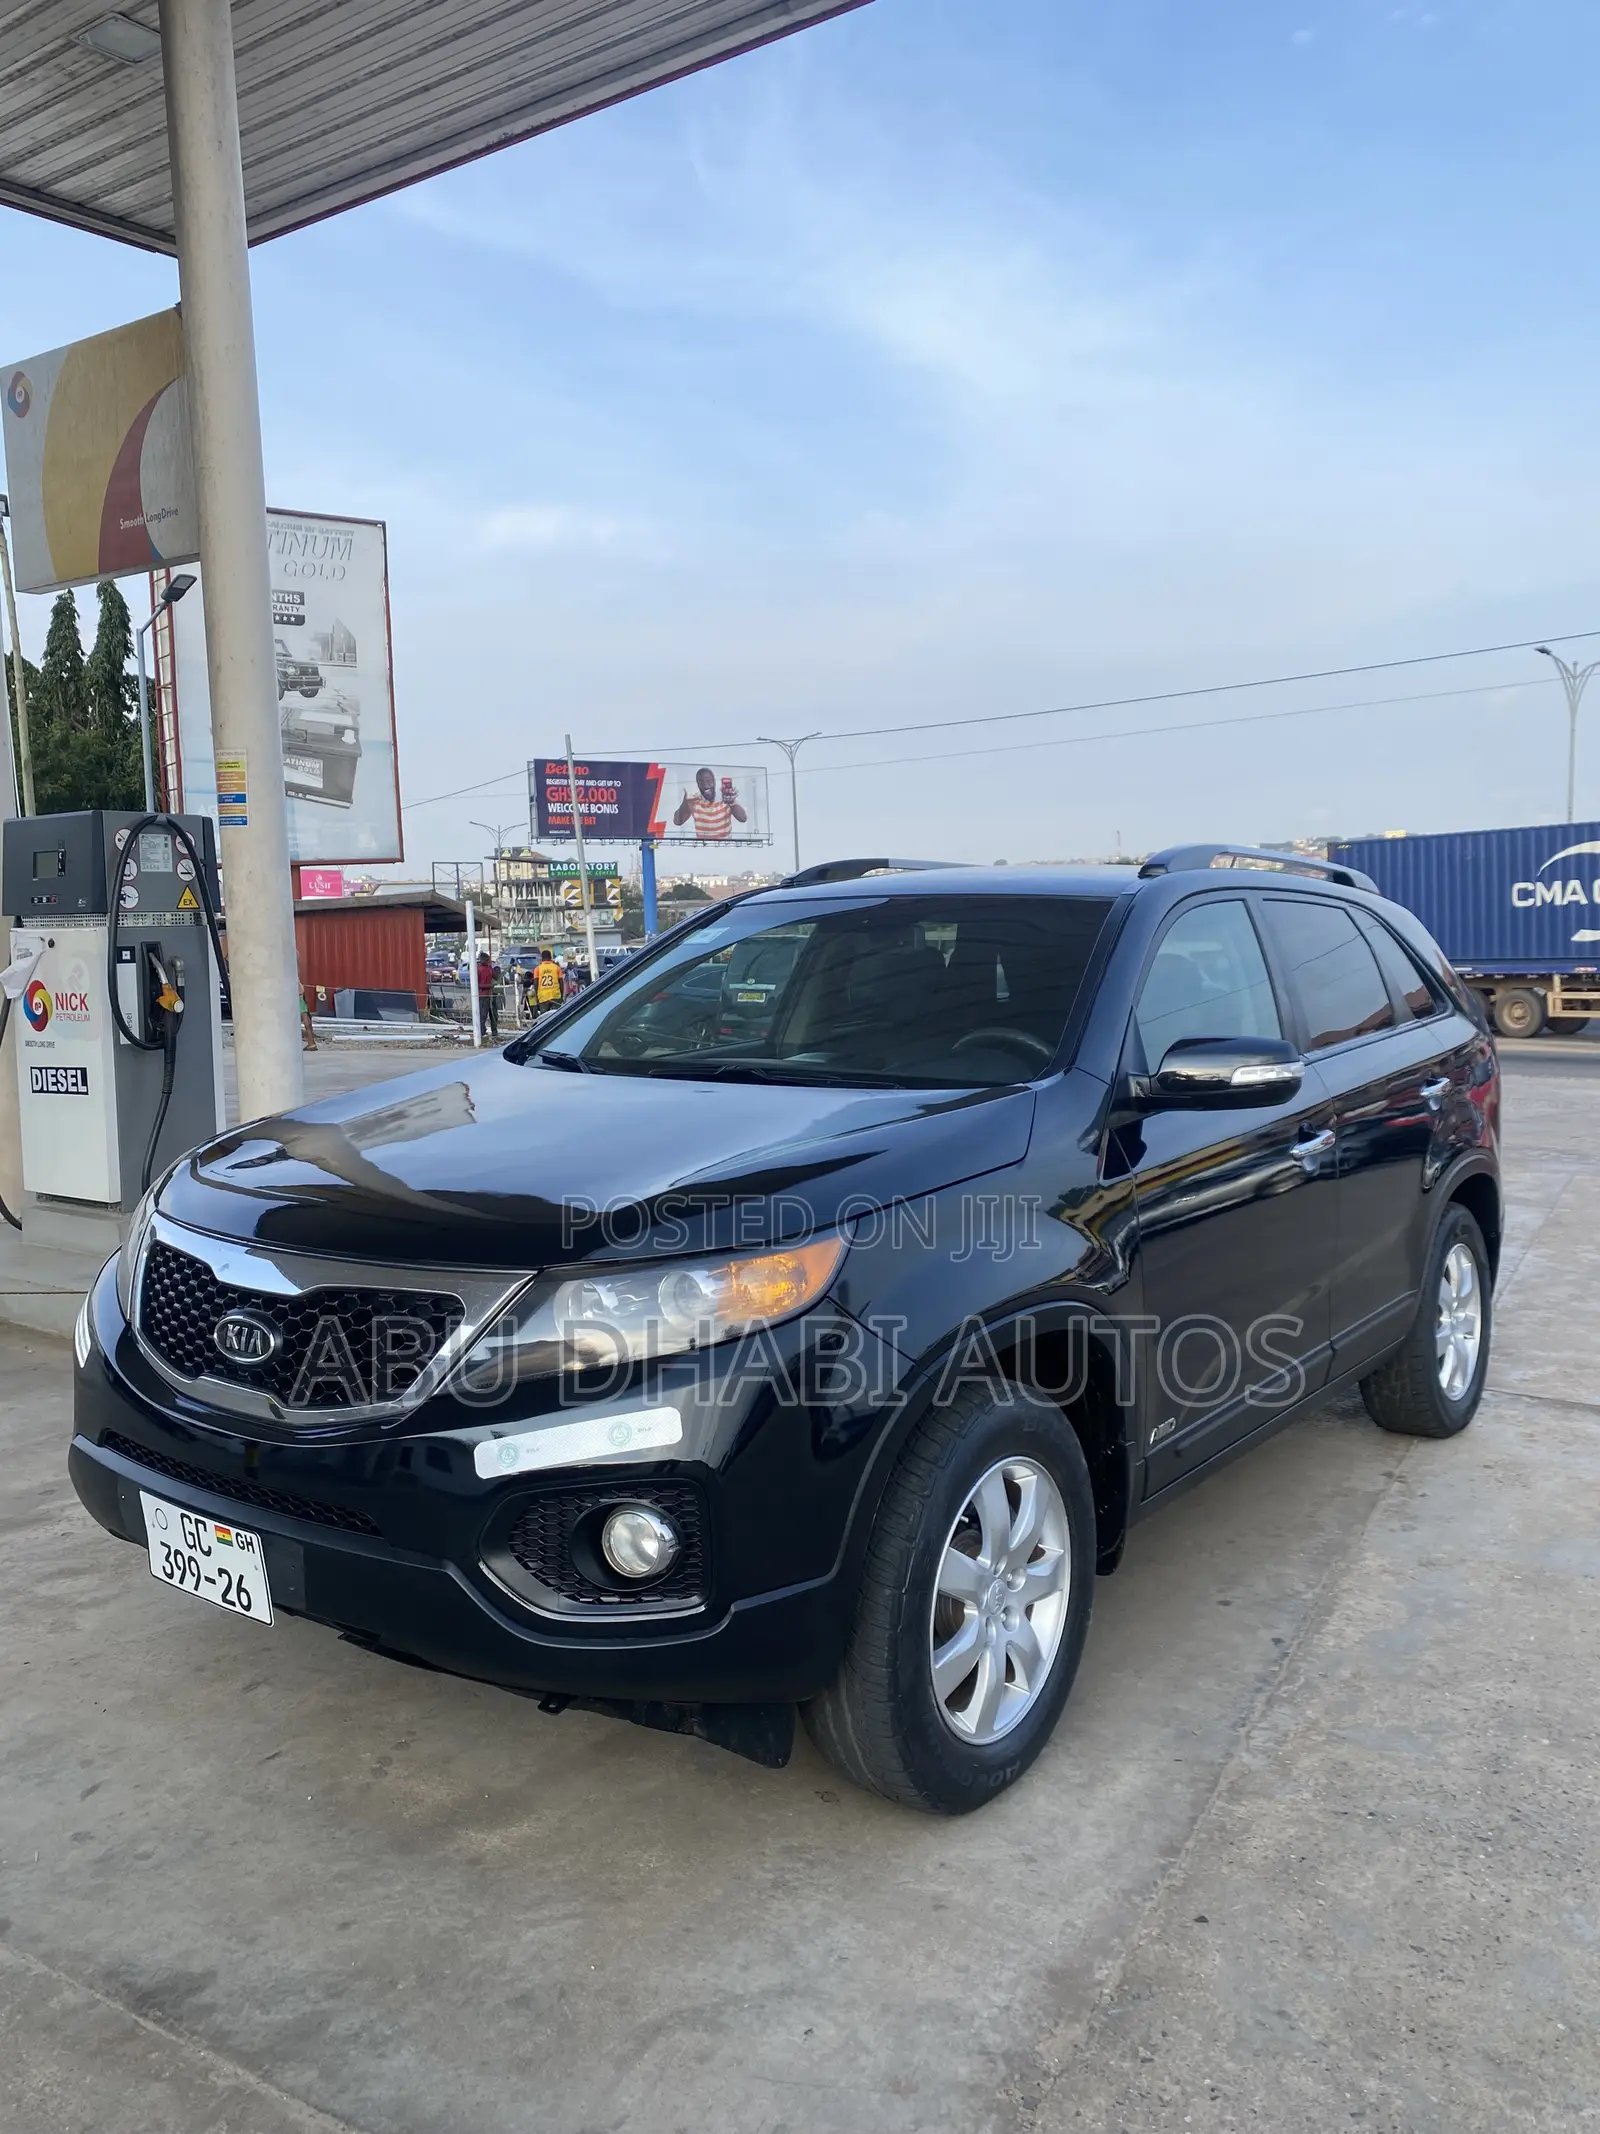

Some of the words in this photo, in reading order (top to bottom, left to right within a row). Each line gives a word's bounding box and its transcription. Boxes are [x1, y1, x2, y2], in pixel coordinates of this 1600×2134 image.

[119, 512, 145, 530] Smooth
[284, 560, 346, 580] GOLD
[272, 604, 301, 613] RANTY
[545, 762, 589, 775] Betno
[591, 804, 619, 814] BONUS
[548, 815, 570, 825] MAKE
[584, 816, 597, 825] BET
[1511, 880, 1588, 907] CMA
[541, 975, 554, 987] 23
[55, 992, 89, 1011] NICK
[55, 1012, 91, 1021] PETROLEUM
[31, 1068, 88, 1092] DIESEL
[225, 1323, 262, 1355] KIA
[180, 1512, 212, 1557] GC
[235, 1531, 256, 1554] GH
[160, 1540, 252, 1612] 399-26
